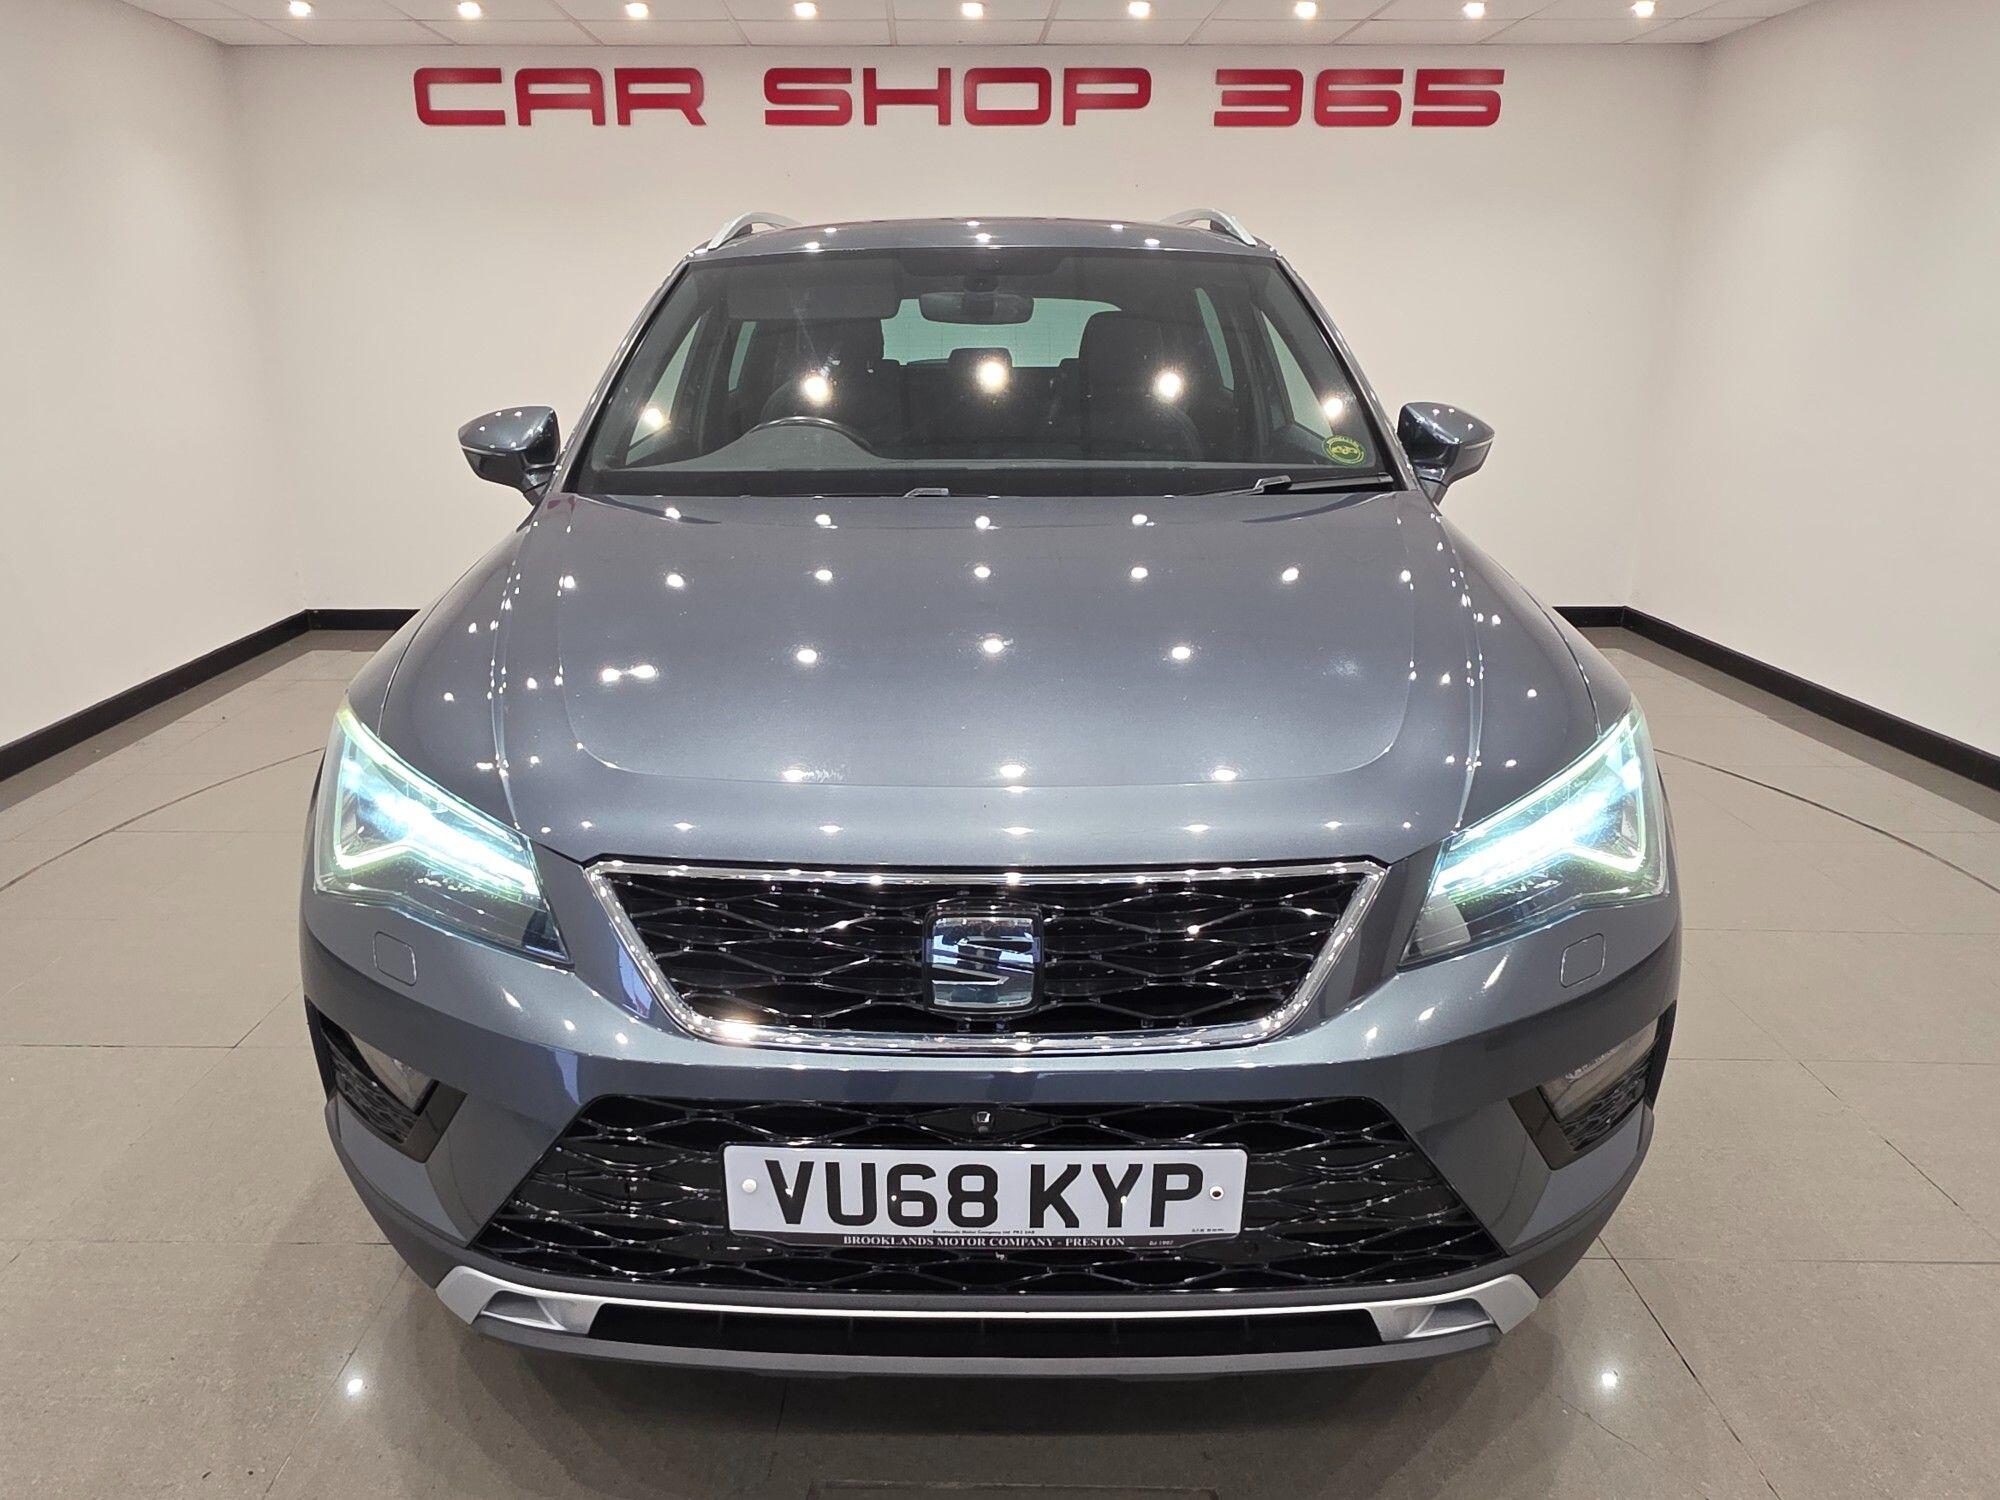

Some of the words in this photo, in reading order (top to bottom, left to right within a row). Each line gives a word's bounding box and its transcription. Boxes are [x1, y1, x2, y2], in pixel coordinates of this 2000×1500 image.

[413, 67, 707, 126] CAR
[763, 67, 1152, 126] SHOP
[1213, 68, 1505, 127] 365
[764, 1159, 998, 1229] VU68
[1028, 1162, 1204, 1229] KYP
[843, 1235, 934, 1246] BROOKLANDS
[937, 1237, 986, 1246] MOTOR
[989, 1237, 1055, 1246] COMPANY
[1065, 1237, 1125, 1246] PRESTON
